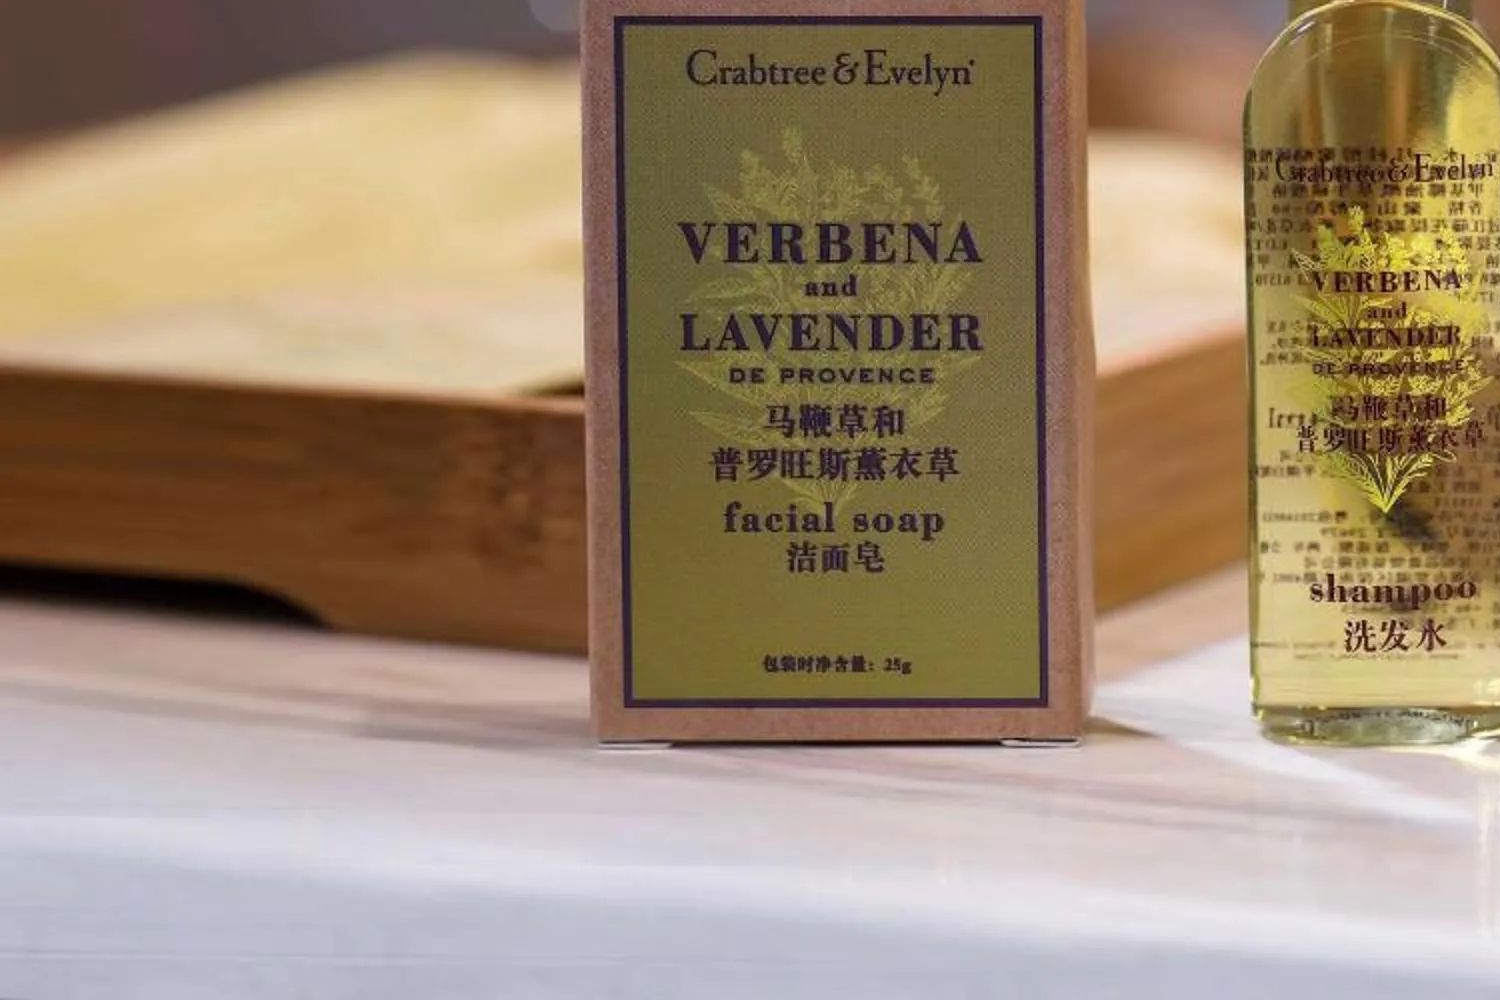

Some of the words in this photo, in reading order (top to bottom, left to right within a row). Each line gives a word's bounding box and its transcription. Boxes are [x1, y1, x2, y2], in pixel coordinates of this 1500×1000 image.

[686, 49, 826, 86] Crabtree
[833, 53, 859, 86] &
[864, 49, 973, 97] Evelyn
[1275, 156, 1384, 184] Crabtree
[677, 220, 983, 265] VERBENA
[804, 274, 858, 297] and
[1313, 268, 1463, 293] VERBENA
[1367, 301, 1407, 320] and
[679, 312, 984, 352] LAVENDER
[1312, 325, 1461, 348] LAVENDER
[729, 367, 765, 384] DE
[780, 367, 935, 384] PROVENCE
[1312, 361, 1337, 375] DE
[1349, 359, 1464, 376] PROVENCE
[764, 403, 905, 438] 马鞭草和
[1332, 394, 1446, 422] 马鞭草和
[708, 447, 960, 482] 普罗旺斯薰衣草
[723, 501, 836, 533] facial
[853, 512, 945, 541] soap
[786, 541, 886, 573] 洁面皂
[1310, 573, 1477, 610] shampoo
[1344, 618, 1447, 653] 洗发水
